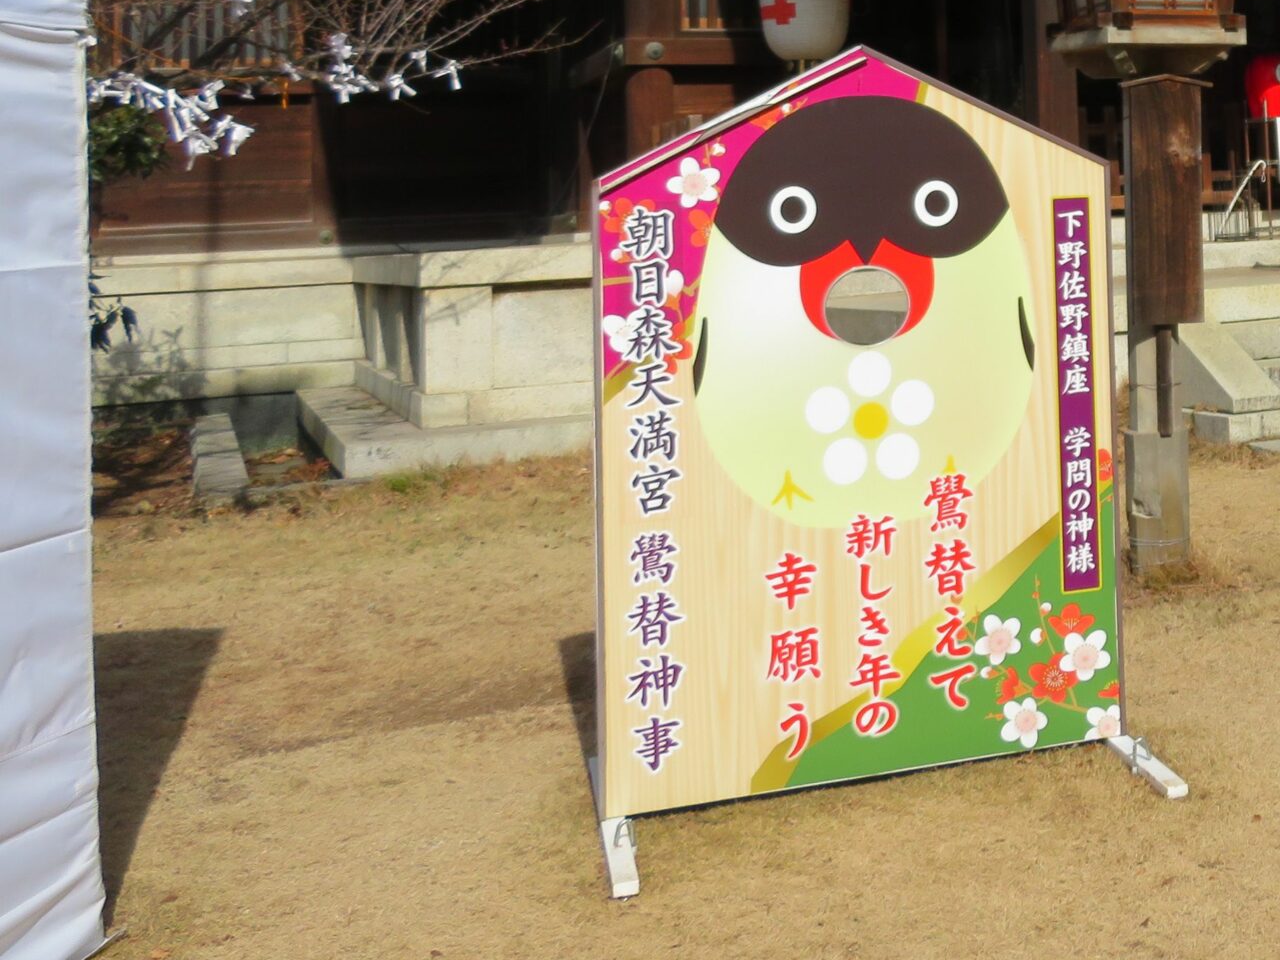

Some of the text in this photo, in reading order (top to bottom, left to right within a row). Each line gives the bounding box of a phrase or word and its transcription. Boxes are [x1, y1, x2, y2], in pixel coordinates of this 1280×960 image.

[623, 208, 682, 515] 朝日森天満宮
[1057, 210, 1096, 574] 下野佐野鎮座 学問の神様
[845, 514, 901, 736] 新しき年の
